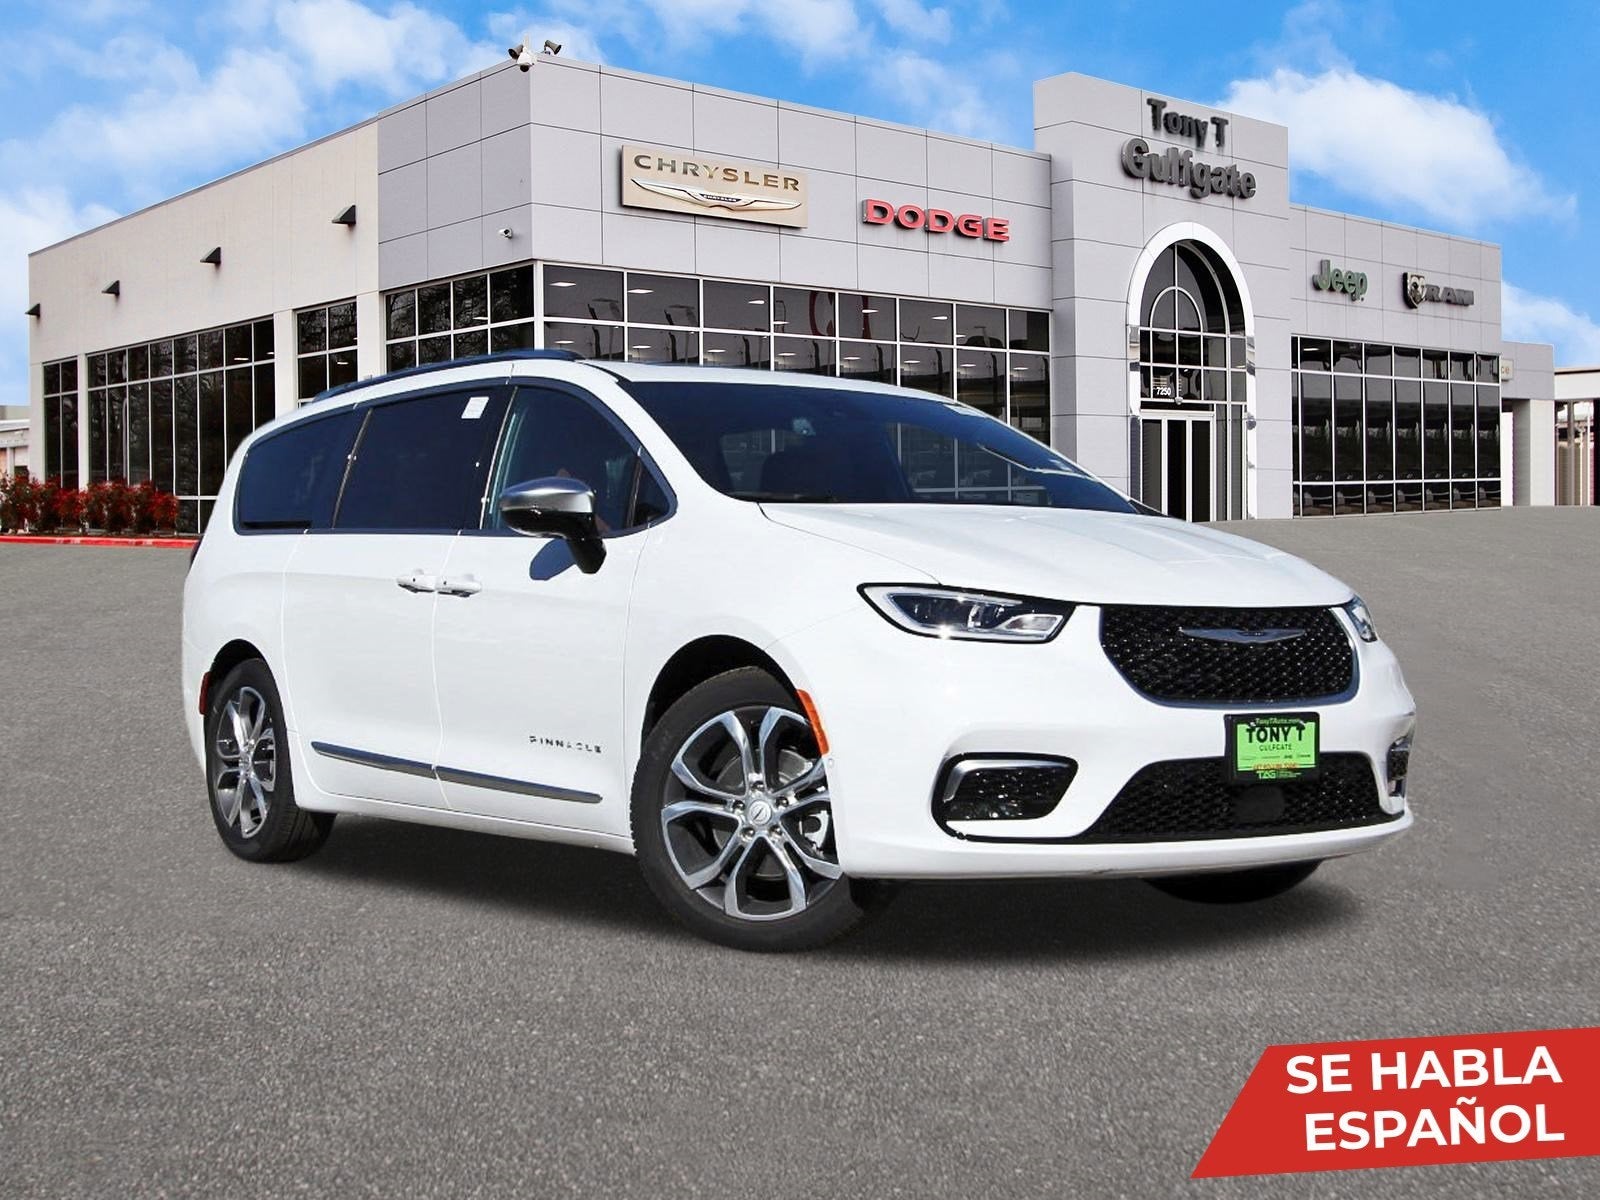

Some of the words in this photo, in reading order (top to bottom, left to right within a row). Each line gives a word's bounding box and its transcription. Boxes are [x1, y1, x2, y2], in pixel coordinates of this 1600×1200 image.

[1147, 98, 1208, 148] Tony
[1210, 116, 1229, 147] T
[633, 154, 800, 192] CHRYSLER
[1121, 137, 1256, 199] Gulfgate
[862, 199, 1010, 242] DODGE
[1312, 259, 1368, 301] Jeep
[1425, 283, 1475, 306] RAM
[1155, 386, 1172, 396] 7250
[529, 735, 602, 754] PINNACLE
[1246, 726, 1291, 743] TONY
[1296, 723, 1306, 741] T
